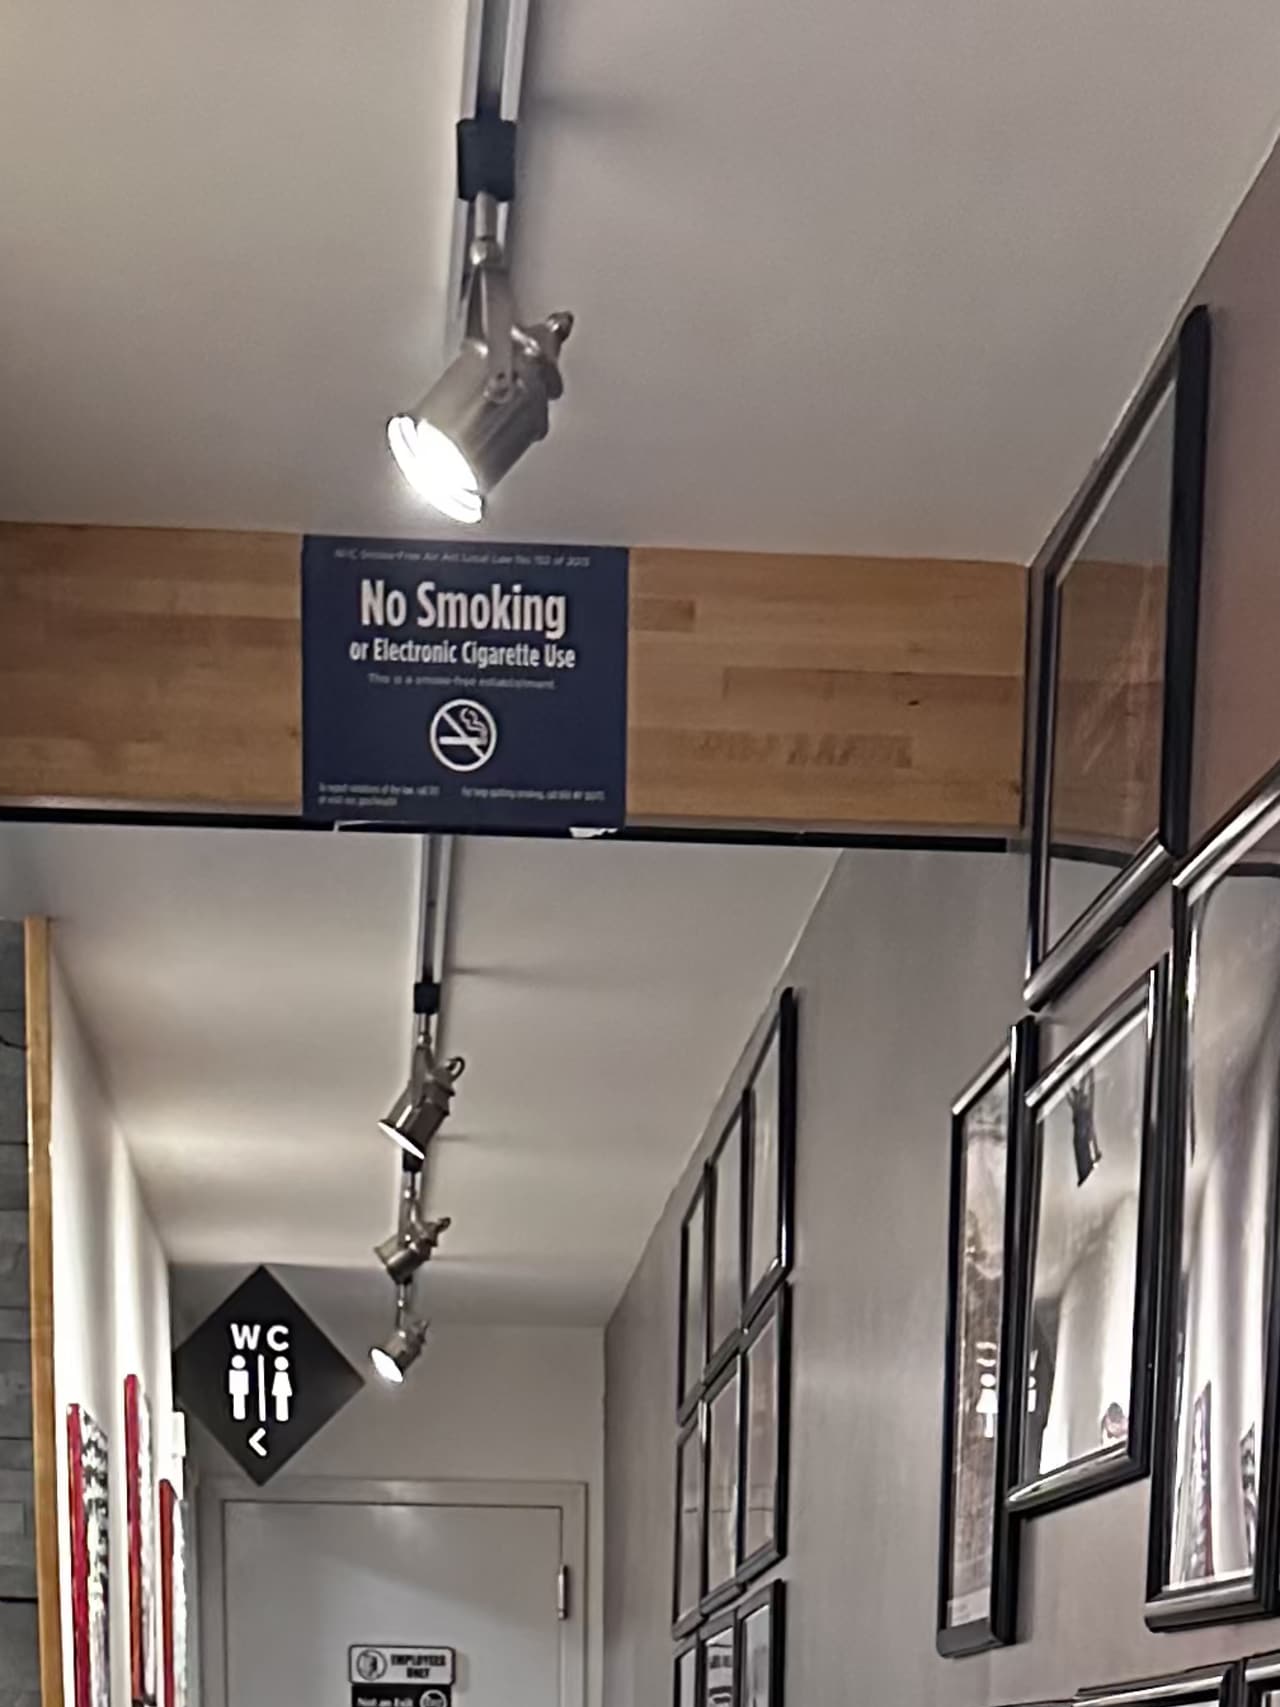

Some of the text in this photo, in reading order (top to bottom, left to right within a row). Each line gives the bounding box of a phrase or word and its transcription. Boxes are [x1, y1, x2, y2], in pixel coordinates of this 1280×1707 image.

[360, 578, 568, 640] No Smoking
[349, 637, 576, 669] or Electronic Cigarette Use
[230, 1322, 290, 1351] WC
[390, 1654, 446, 1667] EMPLOYEES
[406, 1667, 430, 1679] ONLY
